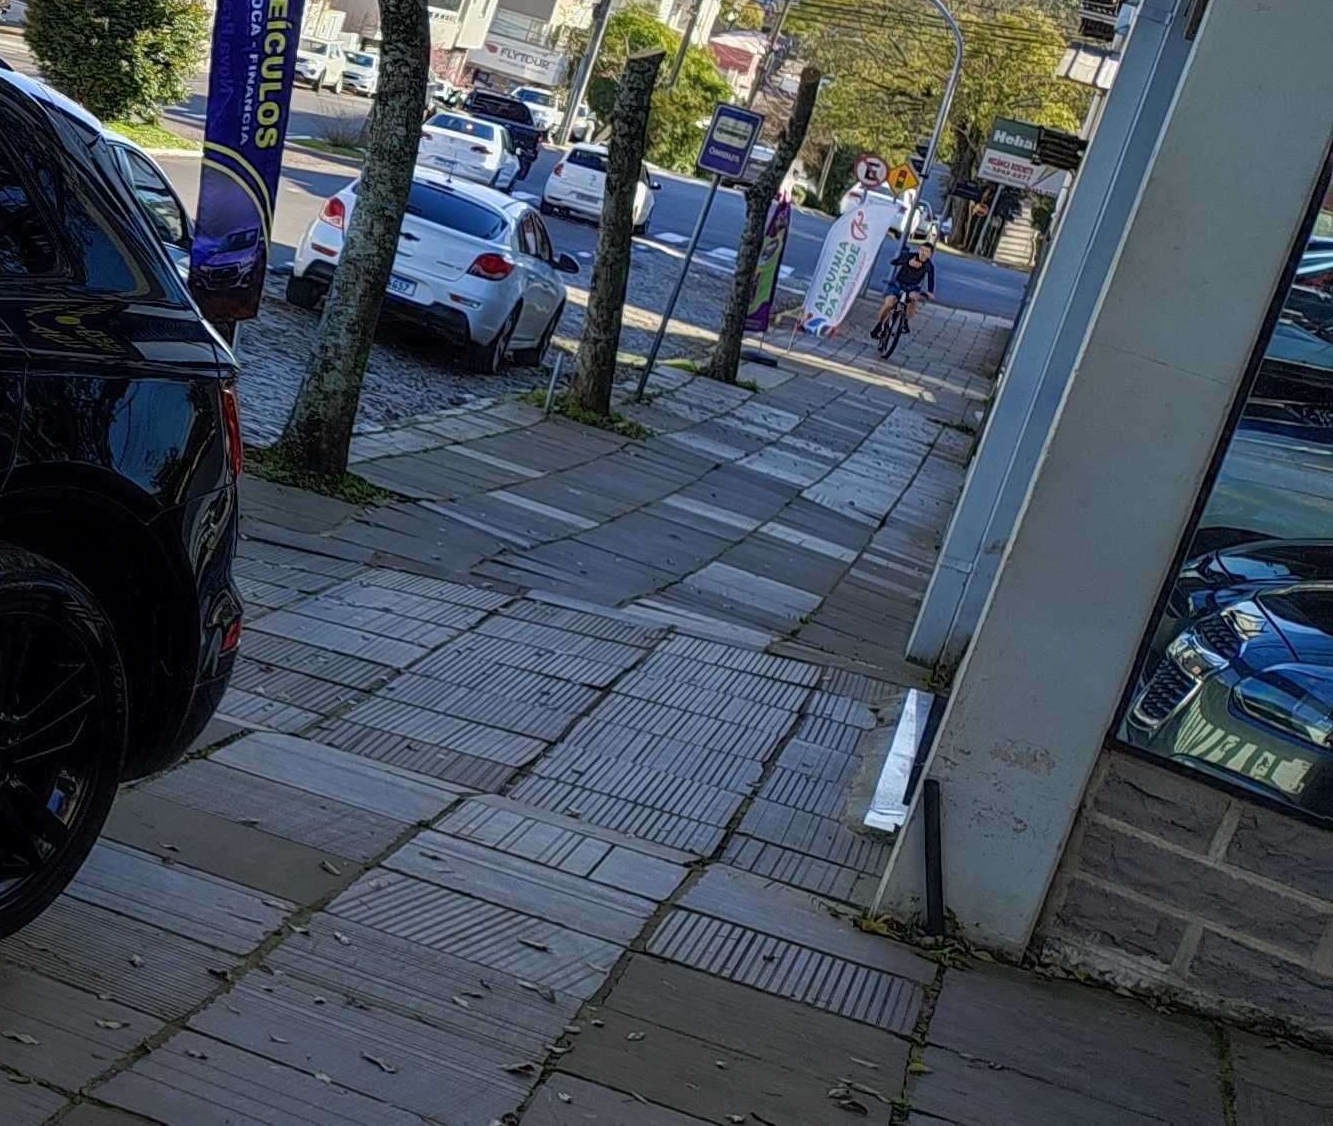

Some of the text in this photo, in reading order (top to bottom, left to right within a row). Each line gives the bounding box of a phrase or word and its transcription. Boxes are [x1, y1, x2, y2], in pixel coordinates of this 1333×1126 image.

[500, 46, 550, 71] FLYTOUR
[239, 52, 260, 147] FINANCIA
[814, 239, 850, 313] ALQUIMIA
[835, 243, 862, 296] SAÚDE
